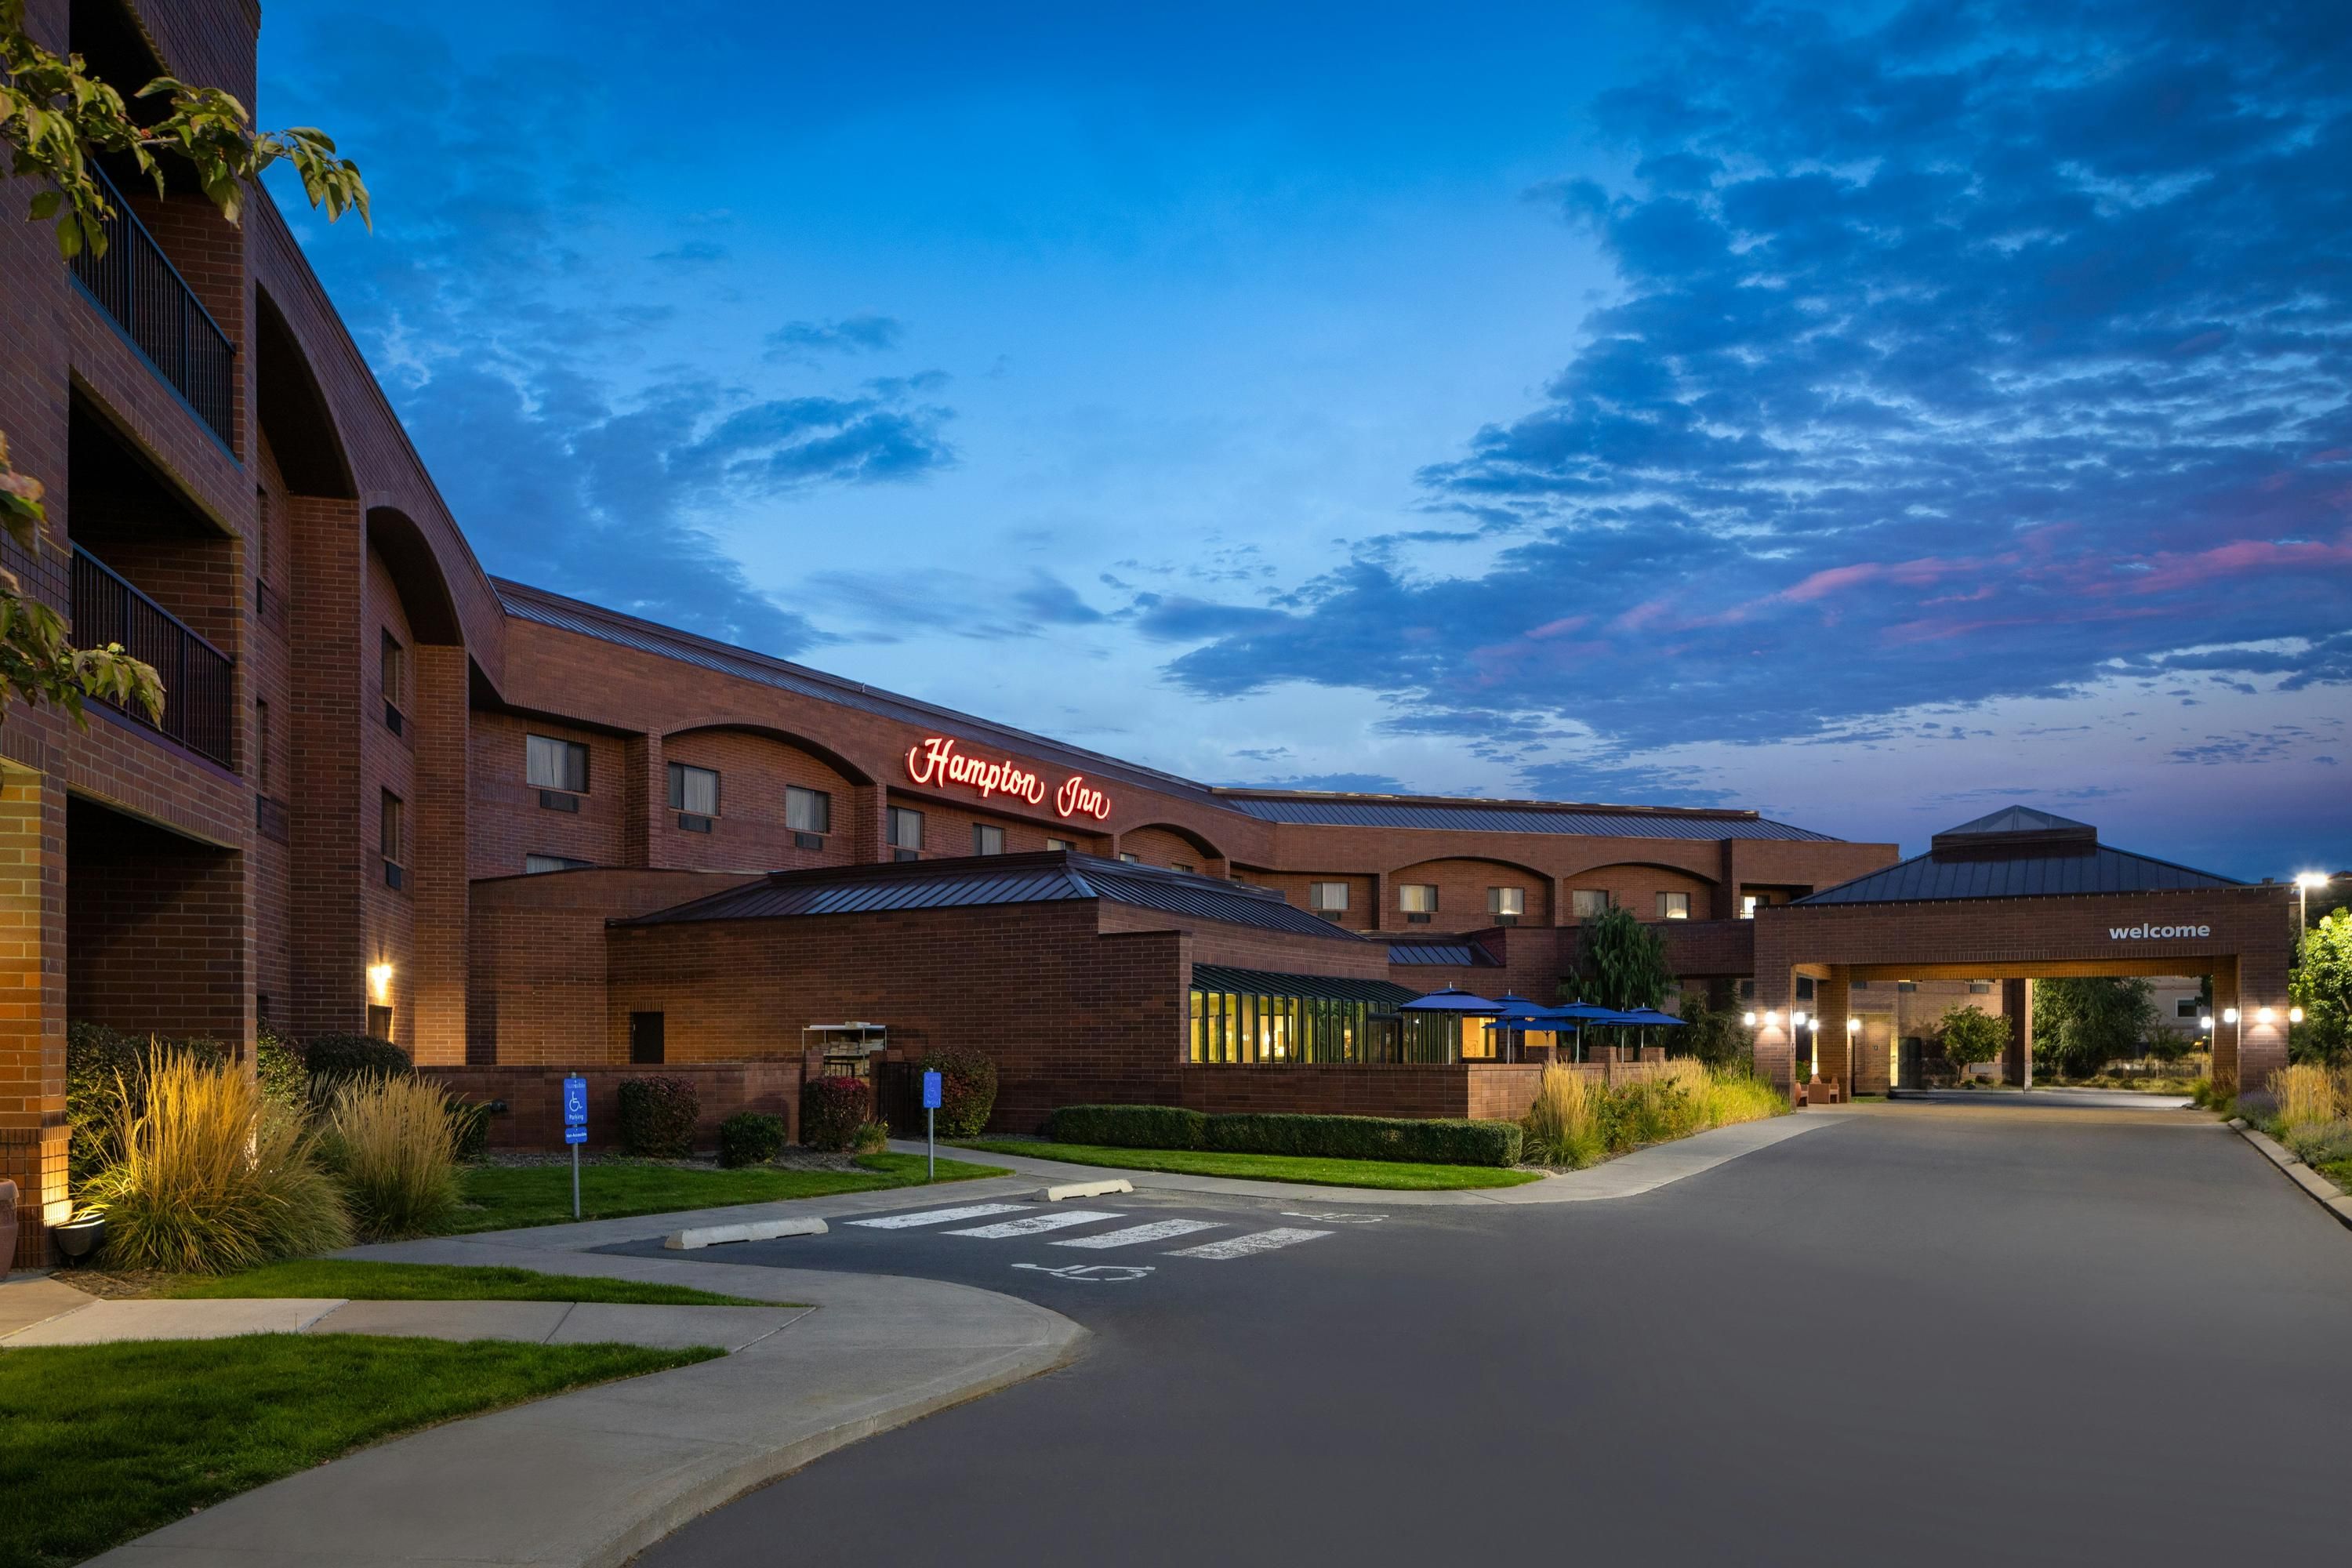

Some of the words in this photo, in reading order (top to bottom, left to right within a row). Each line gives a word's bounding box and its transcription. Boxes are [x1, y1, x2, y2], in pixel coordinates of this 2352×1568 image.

[908, 738, 1045, 804] Hampton
[1057, 776, 1110, 819] Inn
[2108, 923, 2211, 939] welcome
